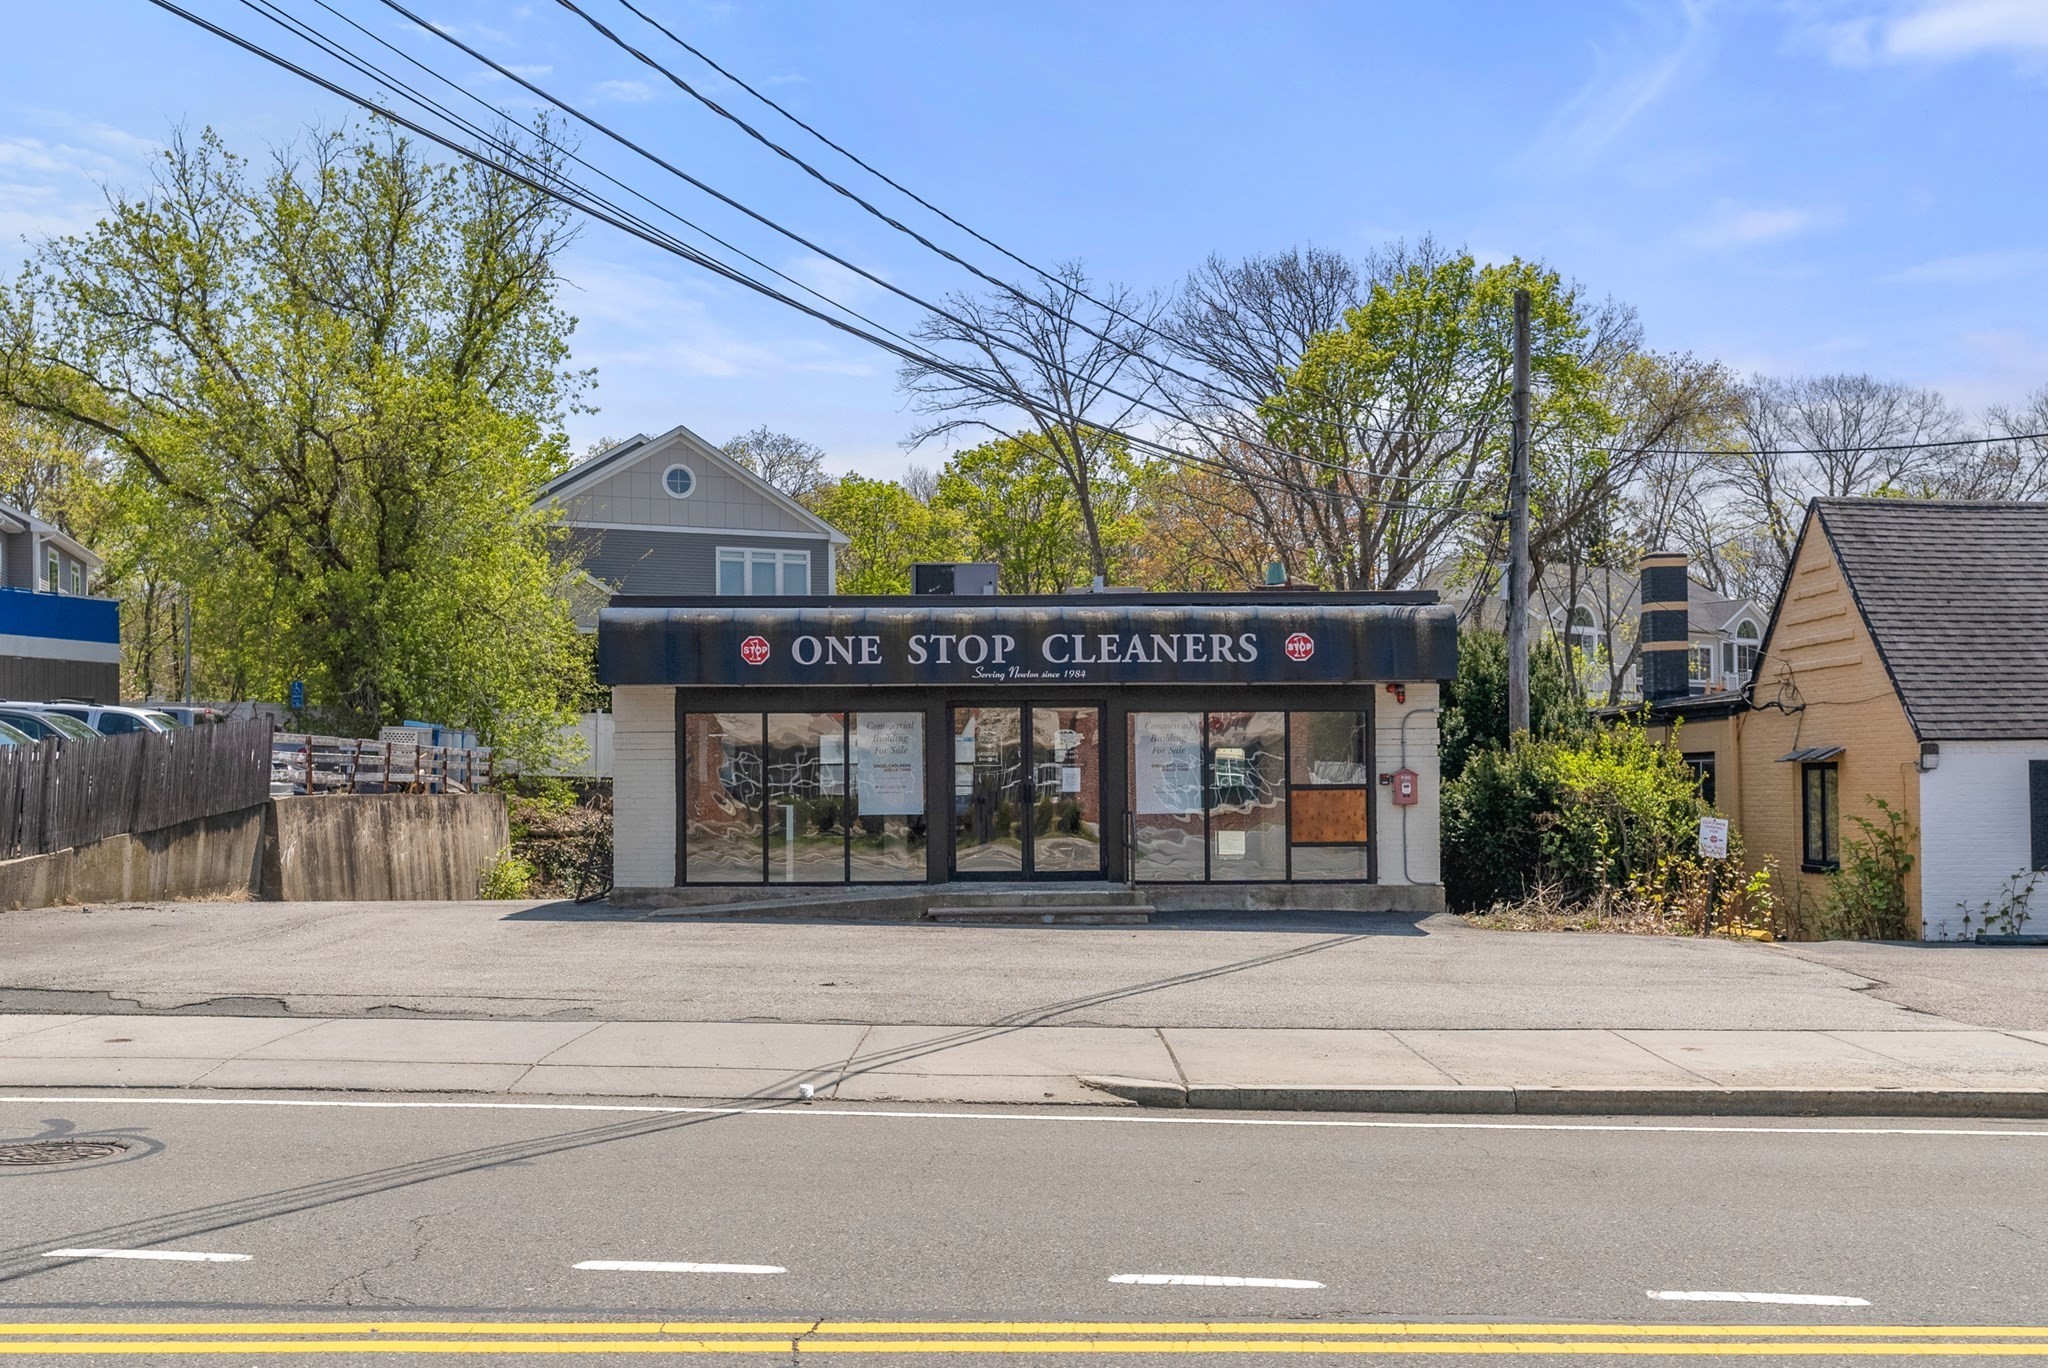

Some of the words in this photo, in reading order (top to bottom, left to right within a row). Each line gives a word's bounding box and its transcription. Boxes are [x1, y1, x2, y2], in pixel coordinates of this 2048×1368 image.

[790, 635, 883, 665] ONE
[906, 633, 1016, 665] STOP
[1041, 632, 1258, 663] CLEANERS
[971, 666, 1006, 681] Serving
[1008, 666, 1039, 679] Newton
[1041, 670, 1060, 678] since
[1063, 669, 1087, 678] 1984
[872, 733, 909, 744] Building
[1150, 733, 1187, 744] Building
[874, 746, 888, 755] For
[890, 745, 908, 755] Sale
[1152, 746, 1166, 755] For
[1168, 745, 1186, 755] Sale
